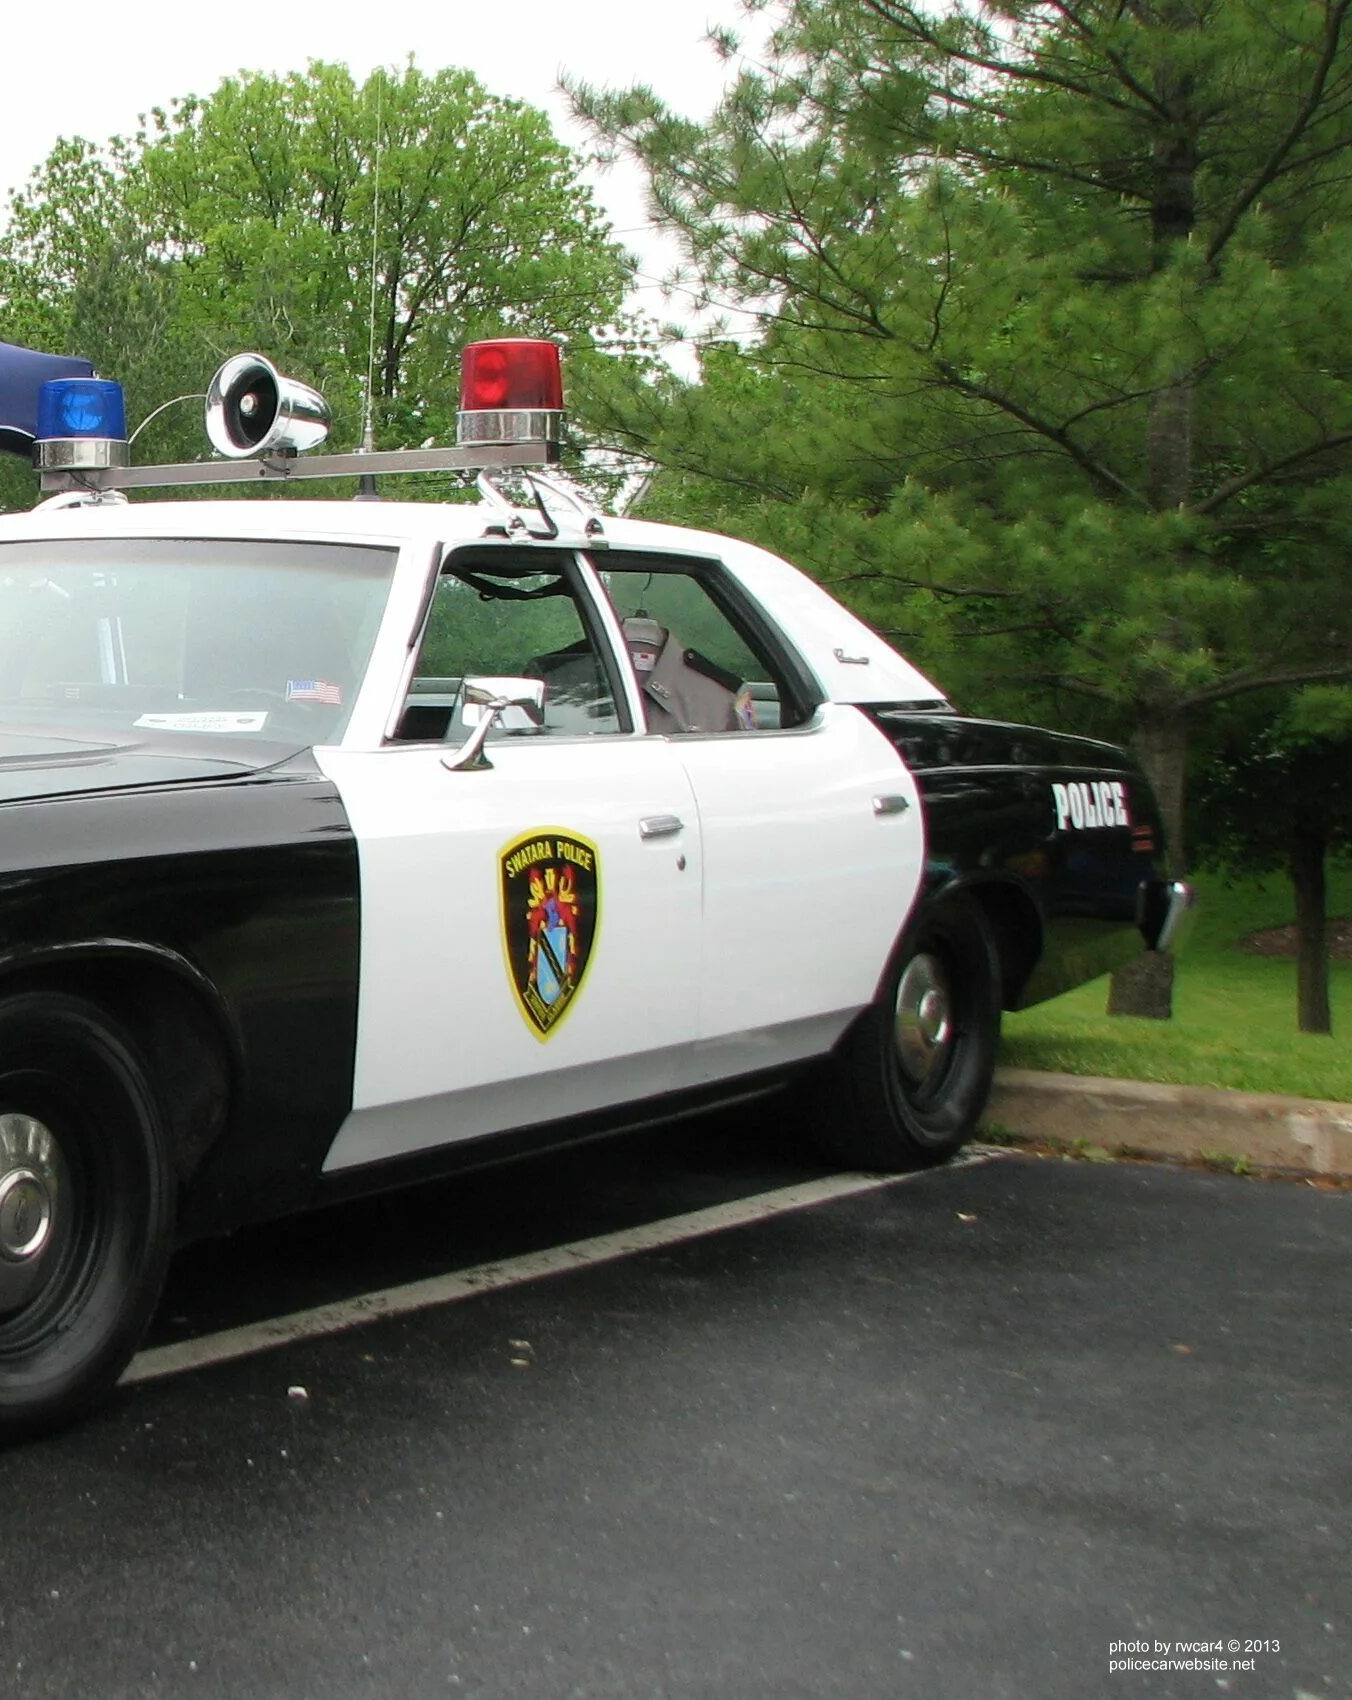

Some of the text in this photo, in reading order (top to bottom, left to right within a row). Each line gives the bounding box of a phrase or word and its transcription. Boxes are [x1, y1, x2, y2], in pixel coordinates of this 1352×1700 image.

[1051, 781, 1130, 830] POLICE
[505, 840, 592, 878] SWATARA POLICE
